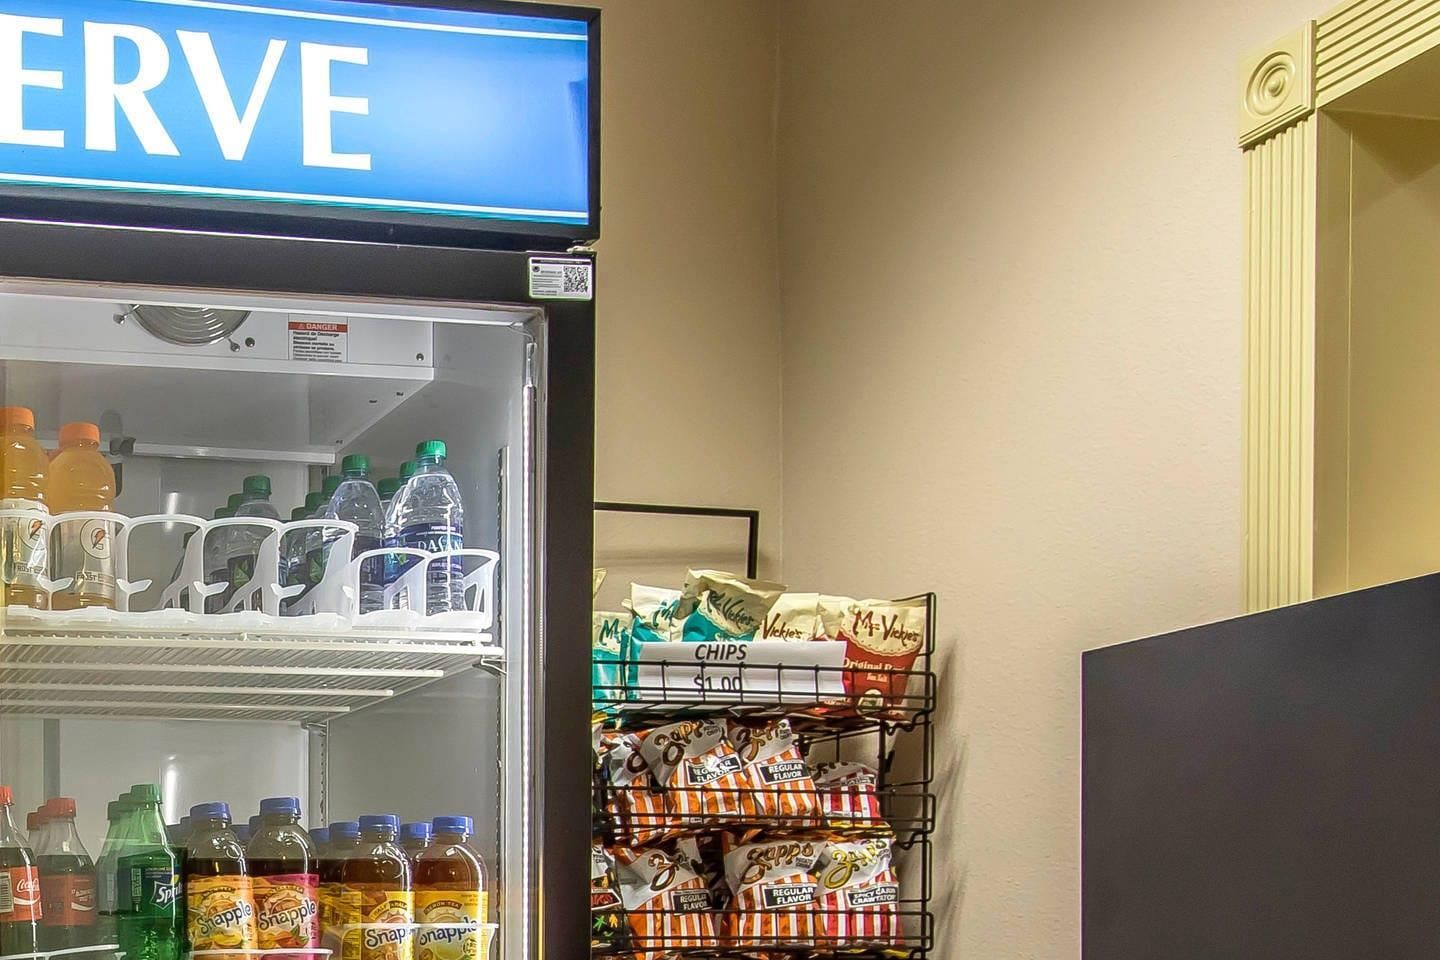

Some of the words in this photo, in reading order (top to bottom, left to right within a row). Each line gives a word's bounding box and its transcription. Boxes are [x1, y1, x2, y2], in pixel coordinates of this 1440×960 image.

[306, 323, 338, 331] DANGER
[881, 615, 920, 647] Vickie's
[694, 644, 748, 661] CHIPS
[694, 673, 742, 694] $1.00
[769, 763, 803, 774] REGULAR
[774, 770, 802, 781] FLAVOR
[773, 887, 814, 897] REGULAR
[777, 894, 812, 905] FLAVOR
[197, 900, 252, 935] Snapple
[259, 898, 316, 930] Snapple
